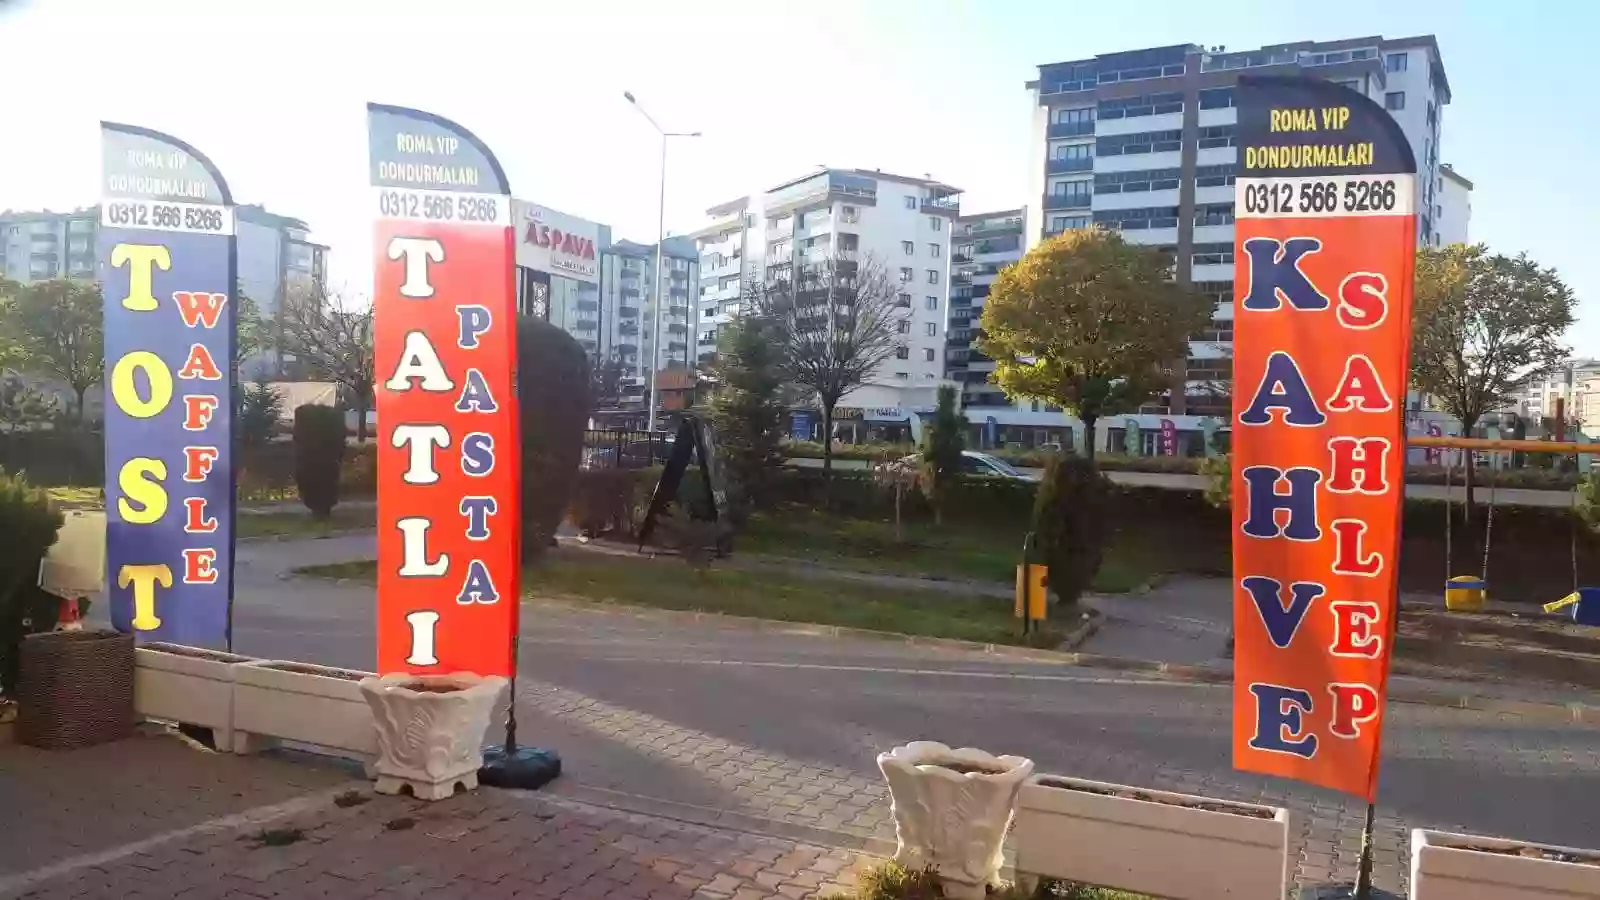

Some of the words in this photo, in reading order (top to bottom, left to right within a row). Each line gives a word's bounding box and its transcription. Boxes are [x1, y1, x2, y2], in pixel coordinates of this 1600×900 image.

[1270, 108, 1317, 133] ROMA
[1322, 106, 1350, 131] VIP
[125, 149, 163, 169] ROMA
[397, 132, 434, 155] ROMA
[1246, 142, 1374, 169] DONDURMALARI
[378, 160, 479, 187] DONDURMALARI
[380, 191, 419, 218] 0312
[424, 194, 453, 220] 566
[458, 196, 497, 222] 5266
[1245, 183, 1293, 214] 0312
[1299, 181, 1338, 213] 566
[1343, 179, 1396, 212] 5266
[108, 202, 148, 226] 0312
[152, 205, 181, 228] 566
[185, 206, 223, 231] 5266
[523, 221, 595, 261] ASPAVA
[111, 243, 174, 632] TOST
[172, 291, 228, 585] WAFFLE
[386, 236, 456, 667] TATLI
[454, 303, 500, 606] PASTA
[1239, 236, 1329, 760] KAHVE
[1325, 271, 1393, 739] SAHLEP
